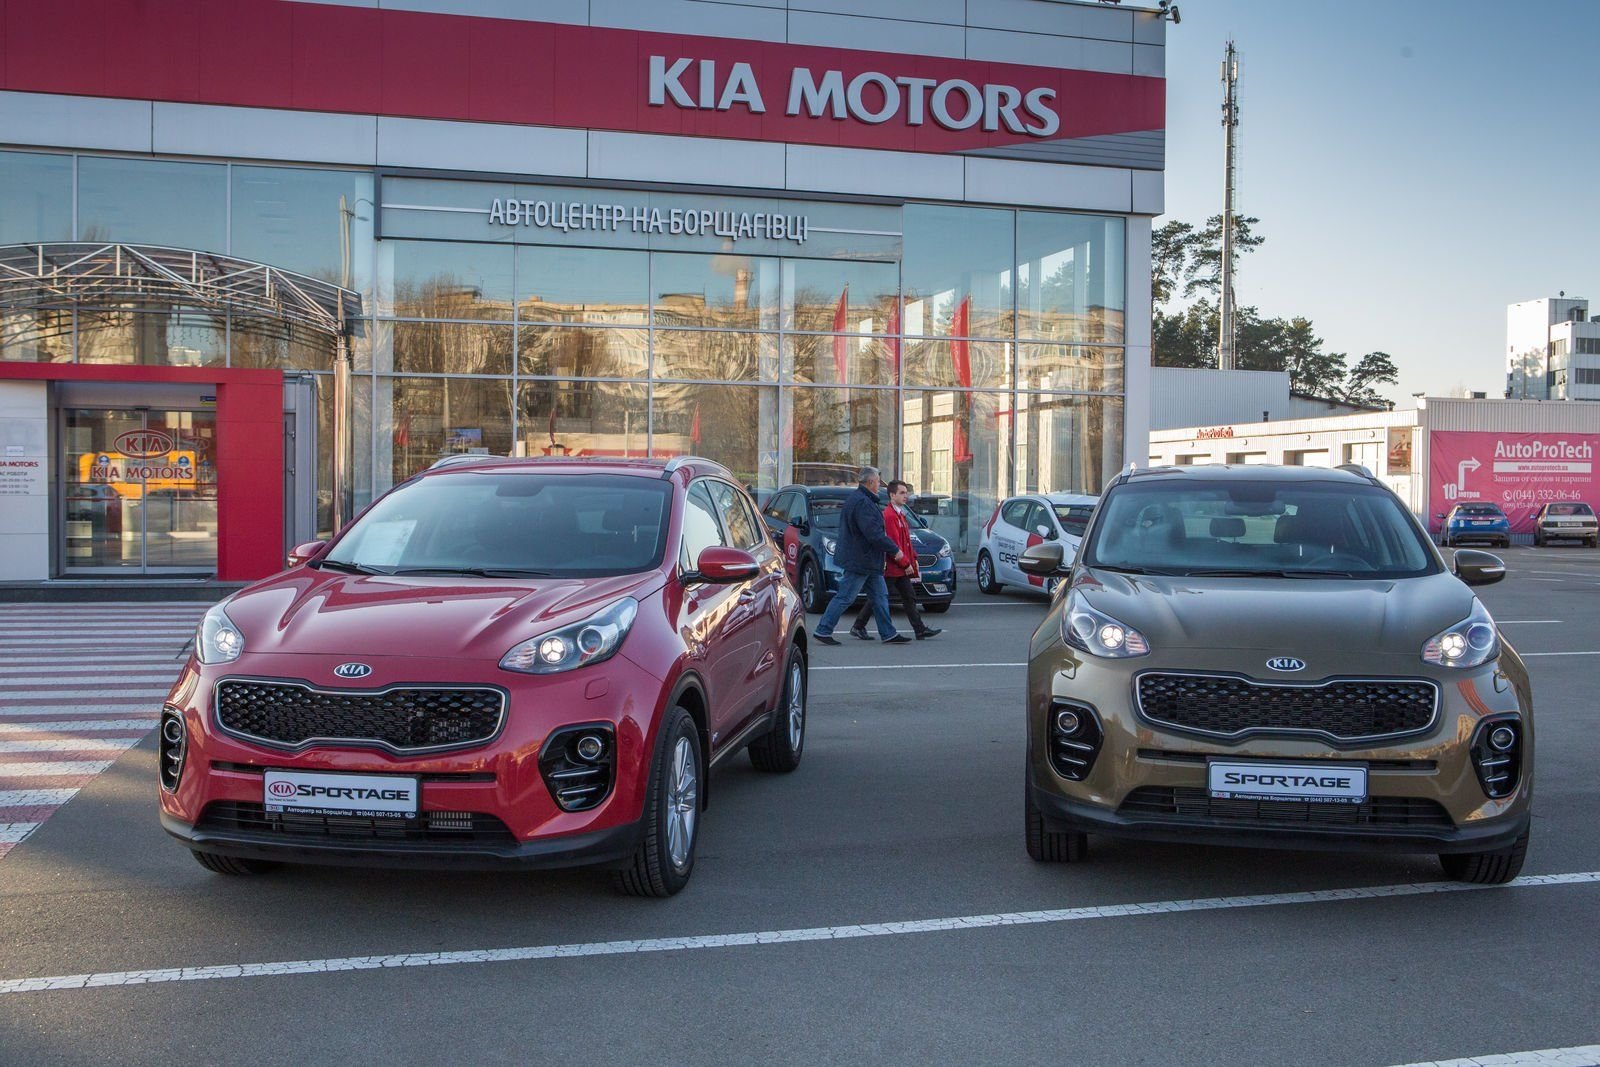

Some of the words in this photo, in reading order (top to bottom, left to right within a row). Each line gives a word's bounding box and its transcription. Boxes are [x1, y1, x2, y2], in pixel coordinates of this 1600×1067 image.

[649, 55, 766, 112] KIA
[786, 67, 1060, 137] MOTORS
[489, 198, 626, 232] АВТОЦЕНТР
[632, 206, 664, 233] НА
[669, 208, 809, 245] БОРЩАГІВЦІ
[124, 436, 165, 453] KIA
[1494, 440, 1592, 458] AutoProTech
[92, 466, 120, 478] KIA
[126, 466, 194, 479] MOTORS
[1494, 473, 1520, 482] Защита
[1442, 483, 1457, 499] 10
[1513, 489, 1535, 502] (044)
[1537, 489, 1581, 500] 332-06-46
[338, 663, 366, 676] KIA
[1271, 658, 1301, 669] KIA
[1224, 772, 1351, 788] SPORTAGE
[297, 784, 410, 801] SPORTAGE
